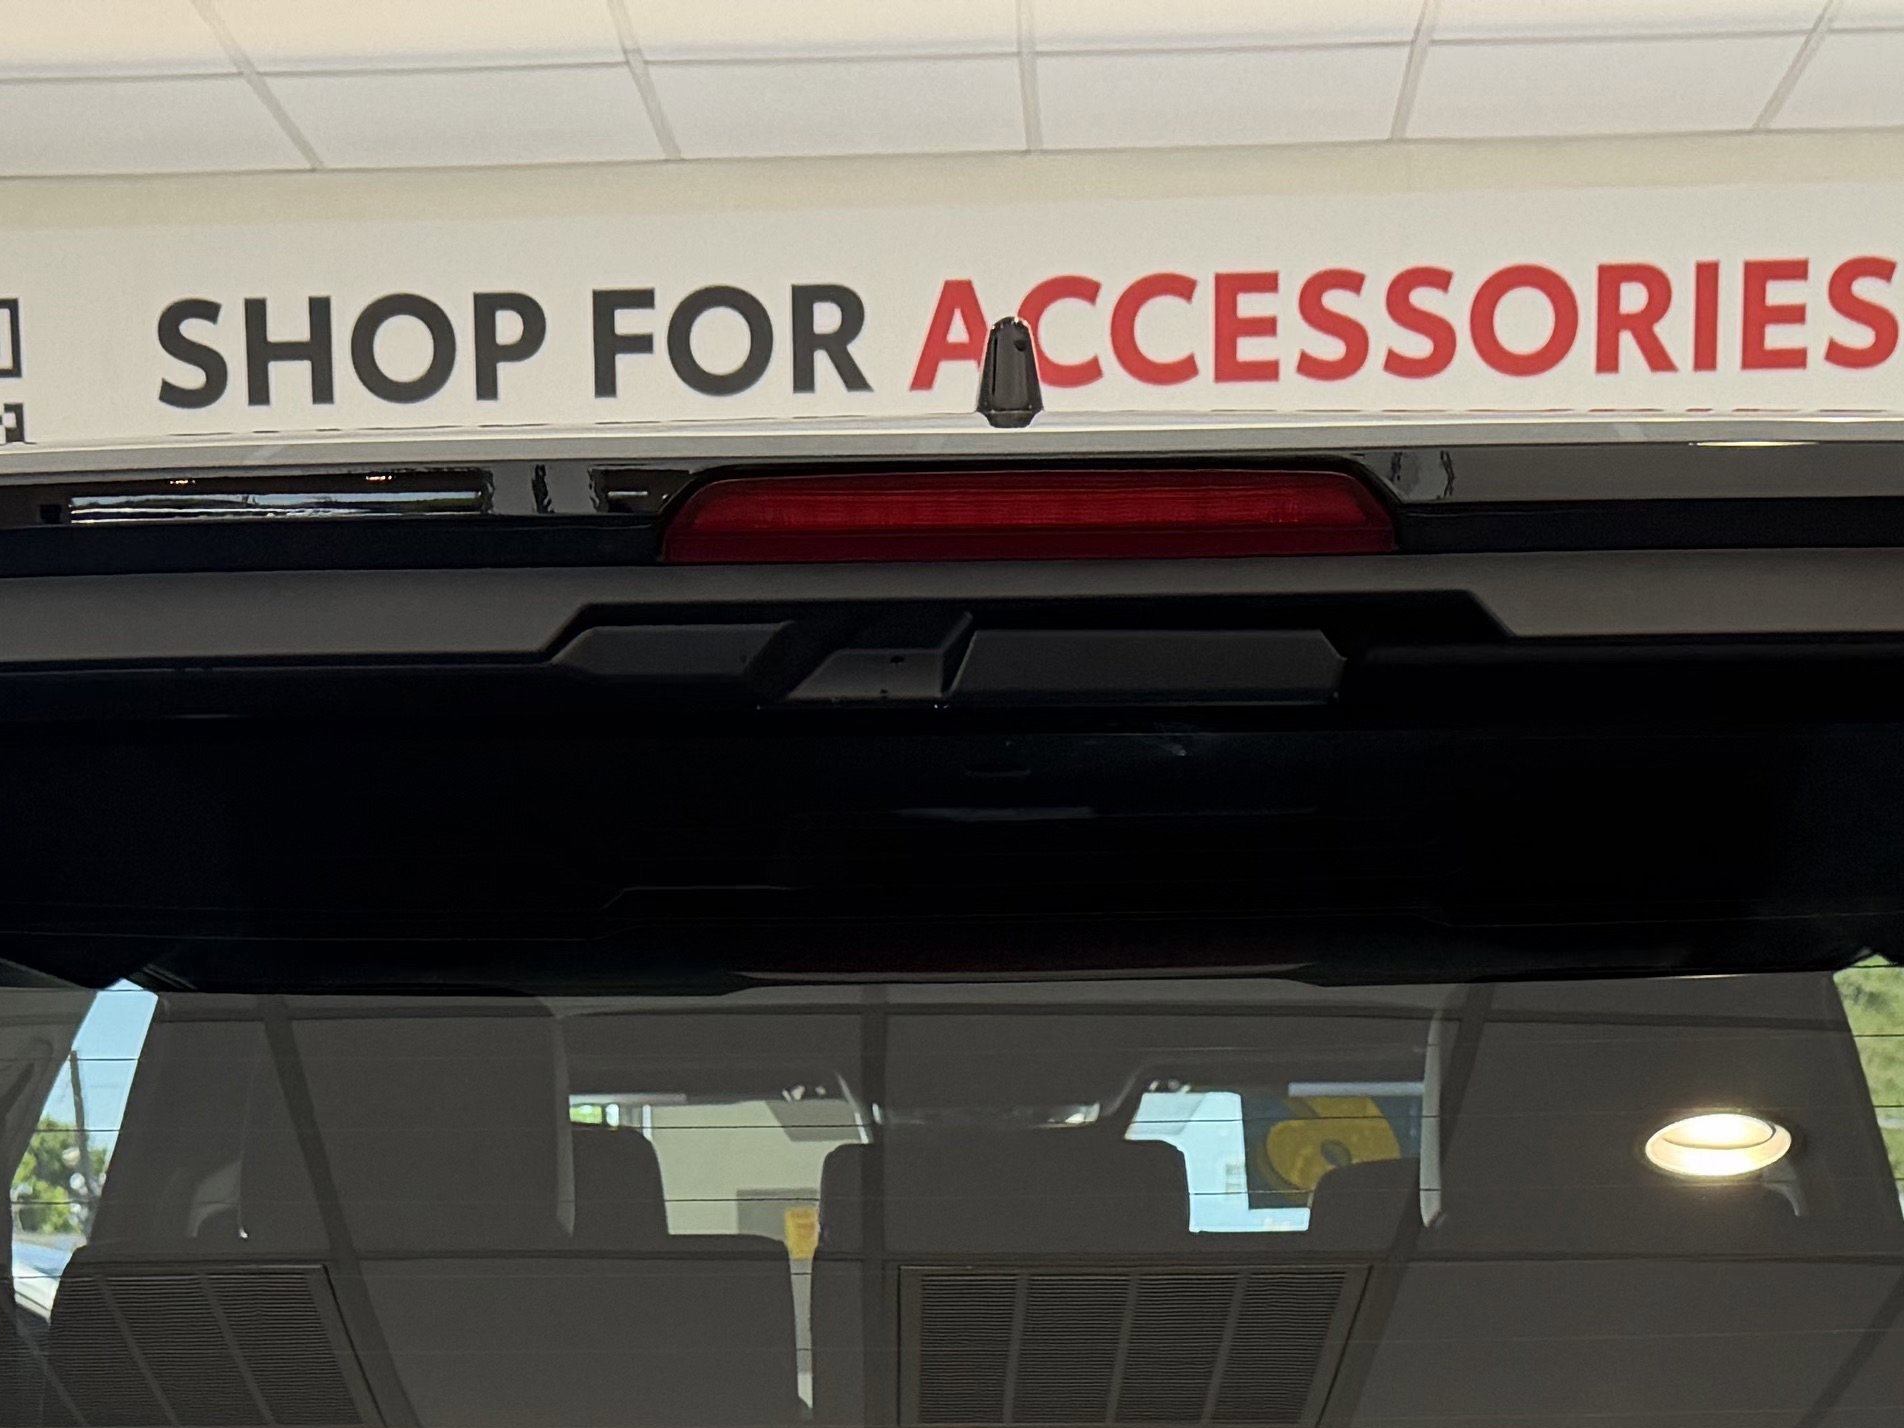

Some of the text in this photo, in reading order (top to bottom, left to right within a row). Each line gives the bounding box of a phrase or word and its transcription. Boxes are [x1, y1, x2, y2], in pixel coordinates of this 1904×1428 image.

[157, 256, 1902, 410] SHOP FOR ACCESSORIES
